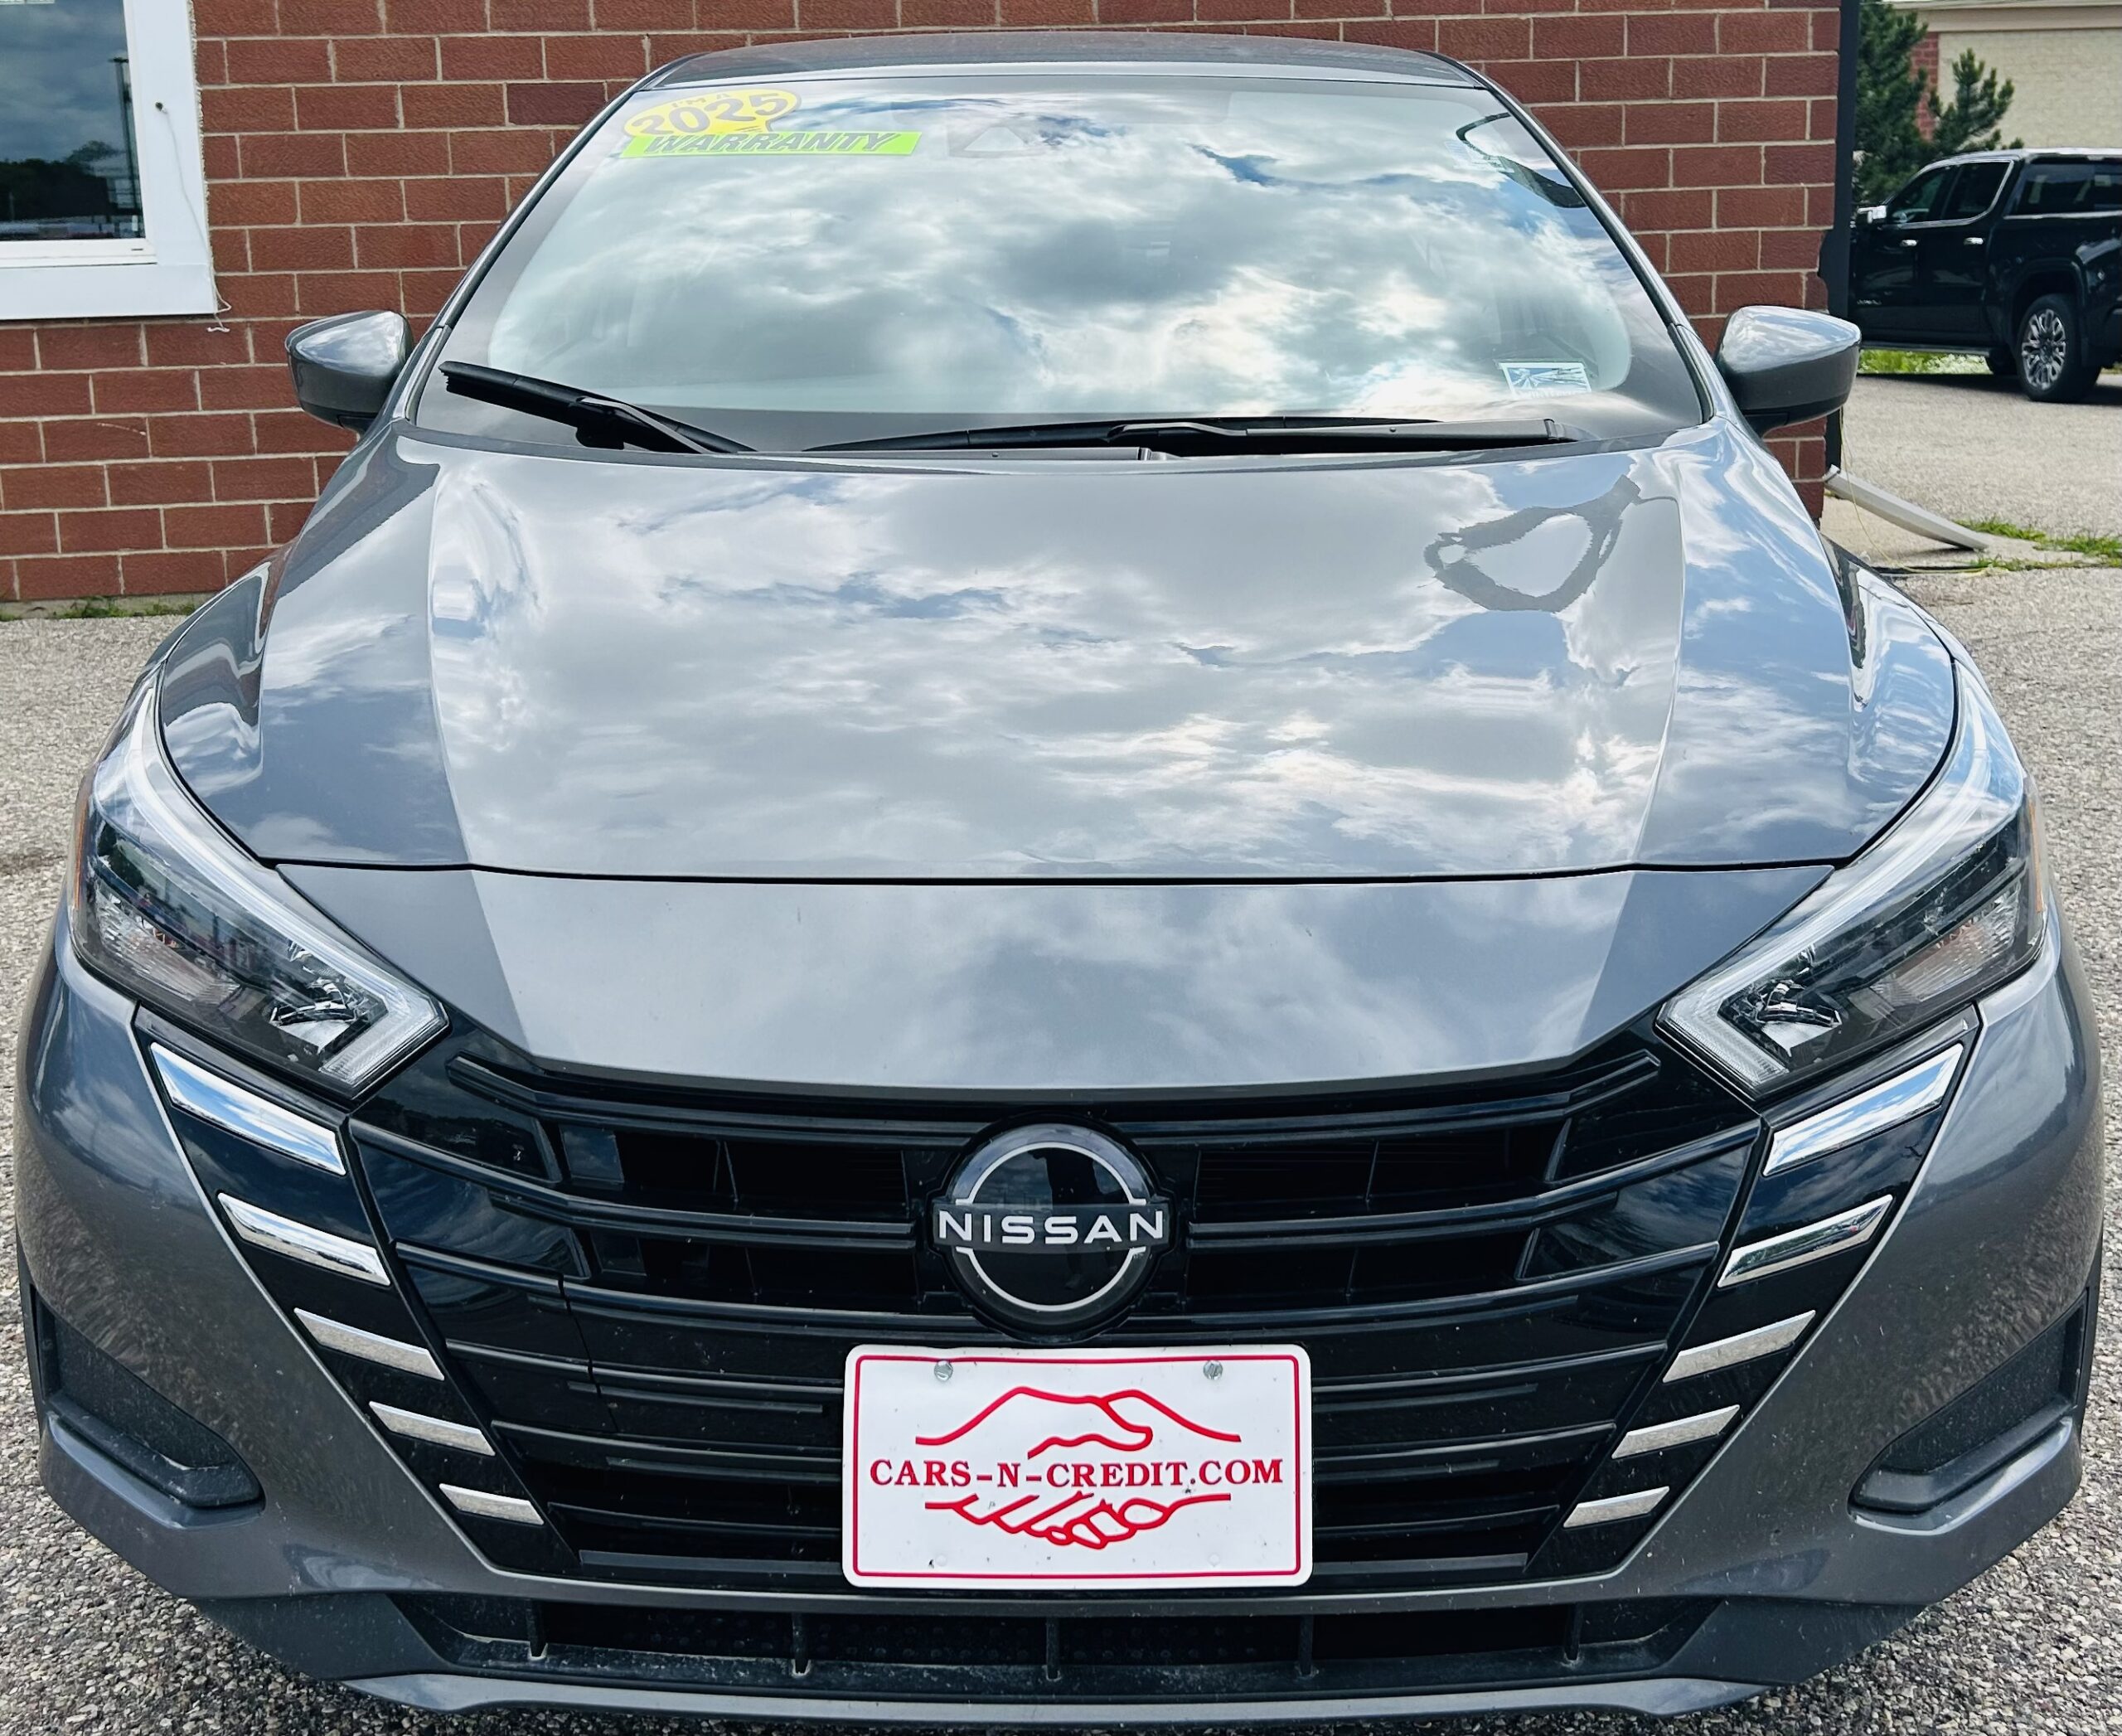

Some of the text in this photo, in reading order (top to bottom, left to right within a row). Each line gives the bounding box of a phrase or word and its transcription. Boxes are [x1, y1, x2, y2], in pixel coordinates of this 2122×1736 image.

[631, 93, 789, 134] 2025
[643, 132, 901, 154] WARRANTY
[938, 1210, 1164, 1244] NISSAN
[870, 1458, 1284, 1489] CARS-N-CREDIT.COM
